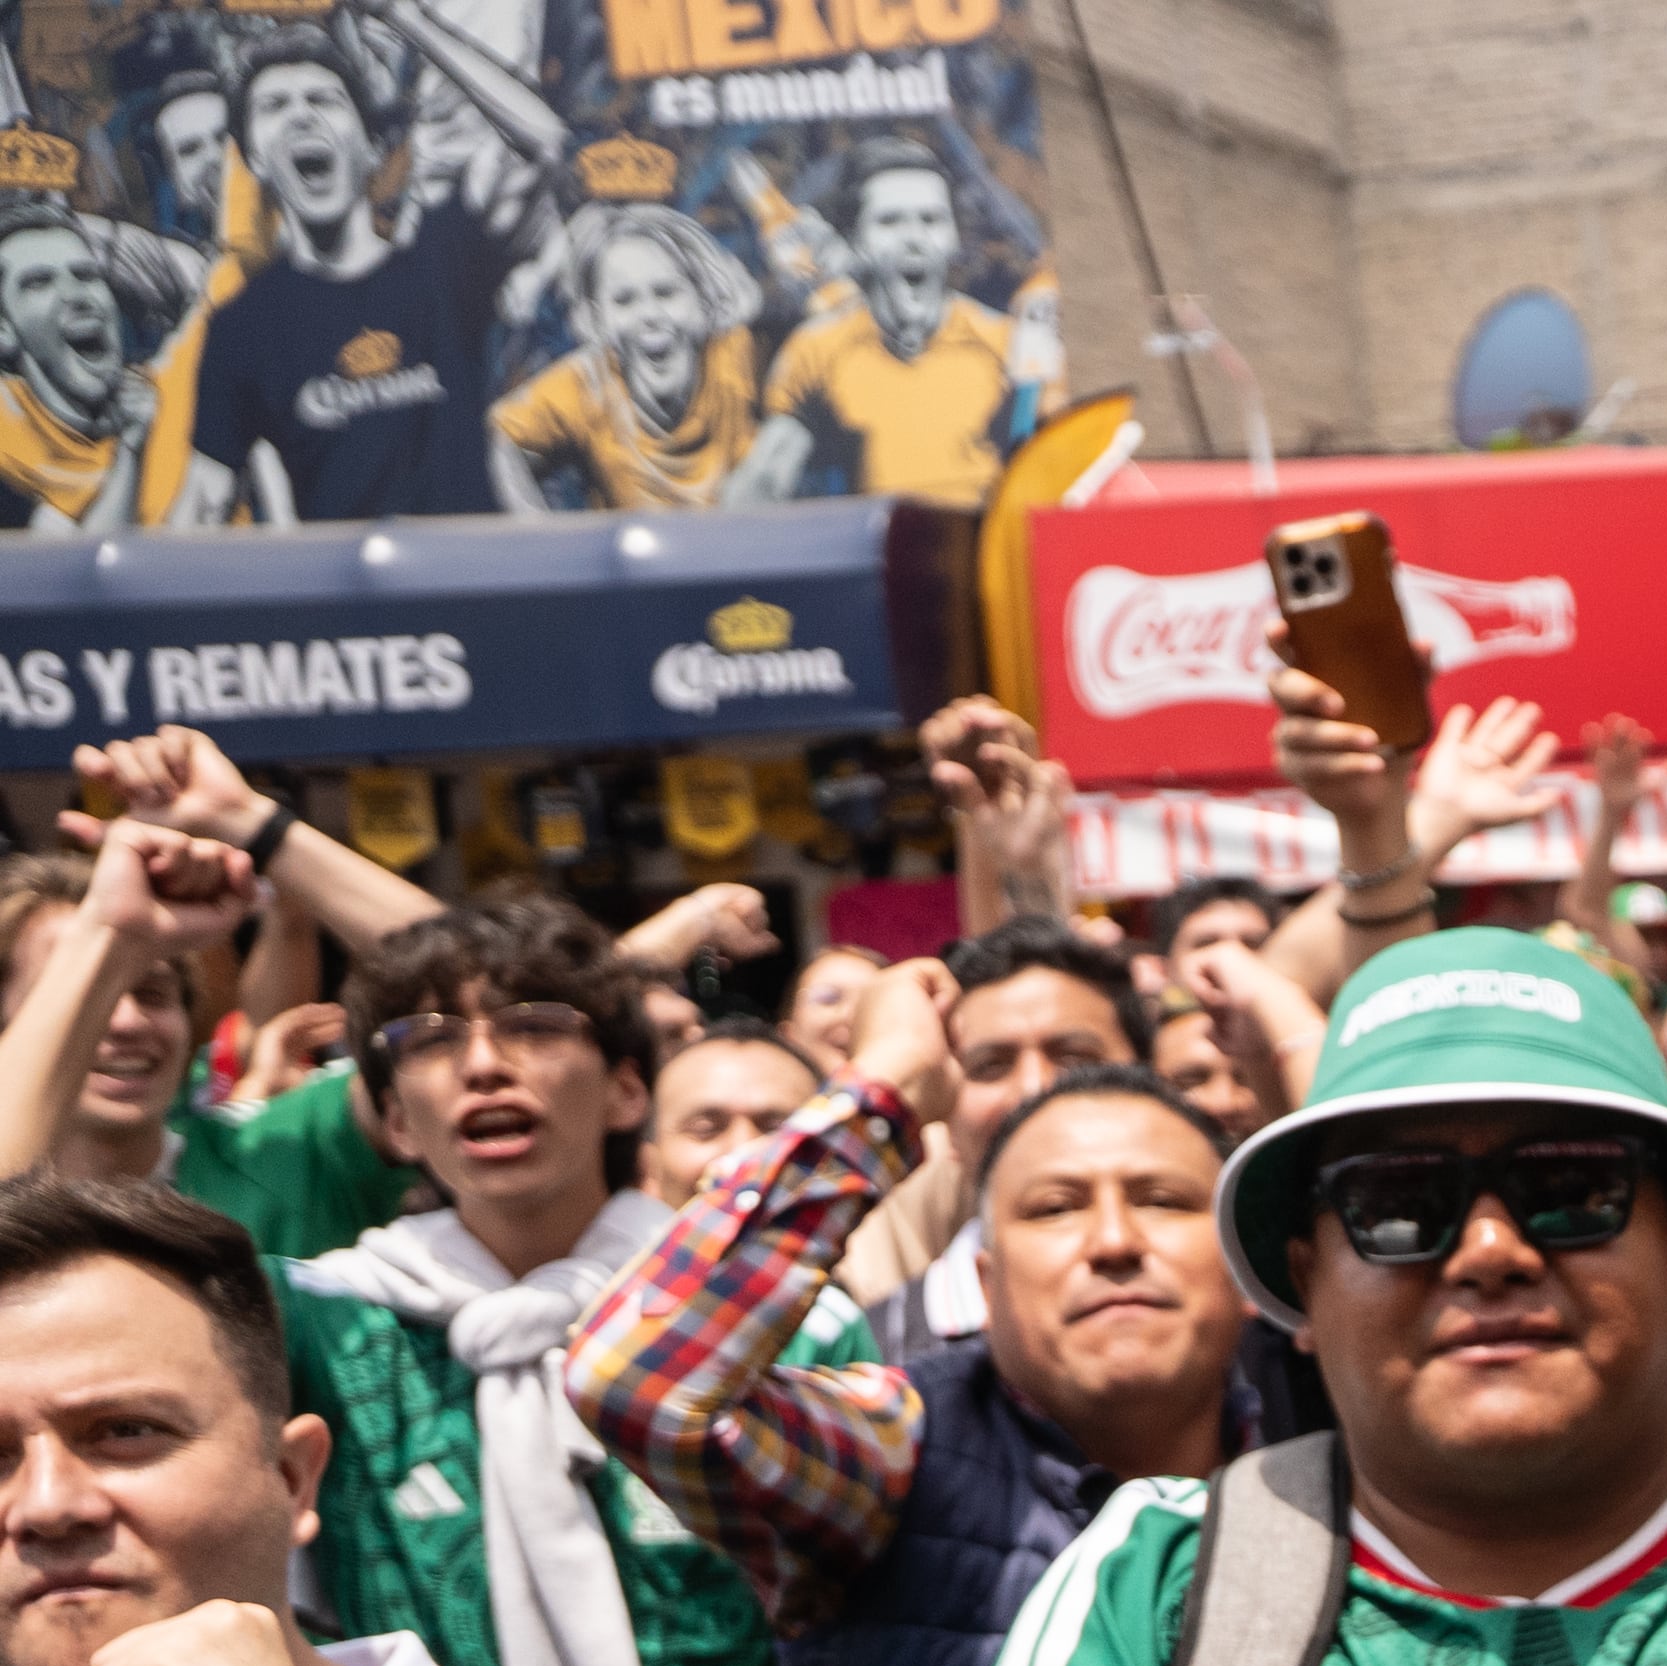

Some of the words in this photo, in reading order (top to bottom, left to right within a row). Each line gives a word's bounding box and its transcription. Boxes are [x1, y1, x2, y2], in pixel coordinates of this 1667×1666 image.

[81, 648, 134, 726] Y
[149, 633, 471, 722] REMATES
[652, 642, 852, 715] Corona
